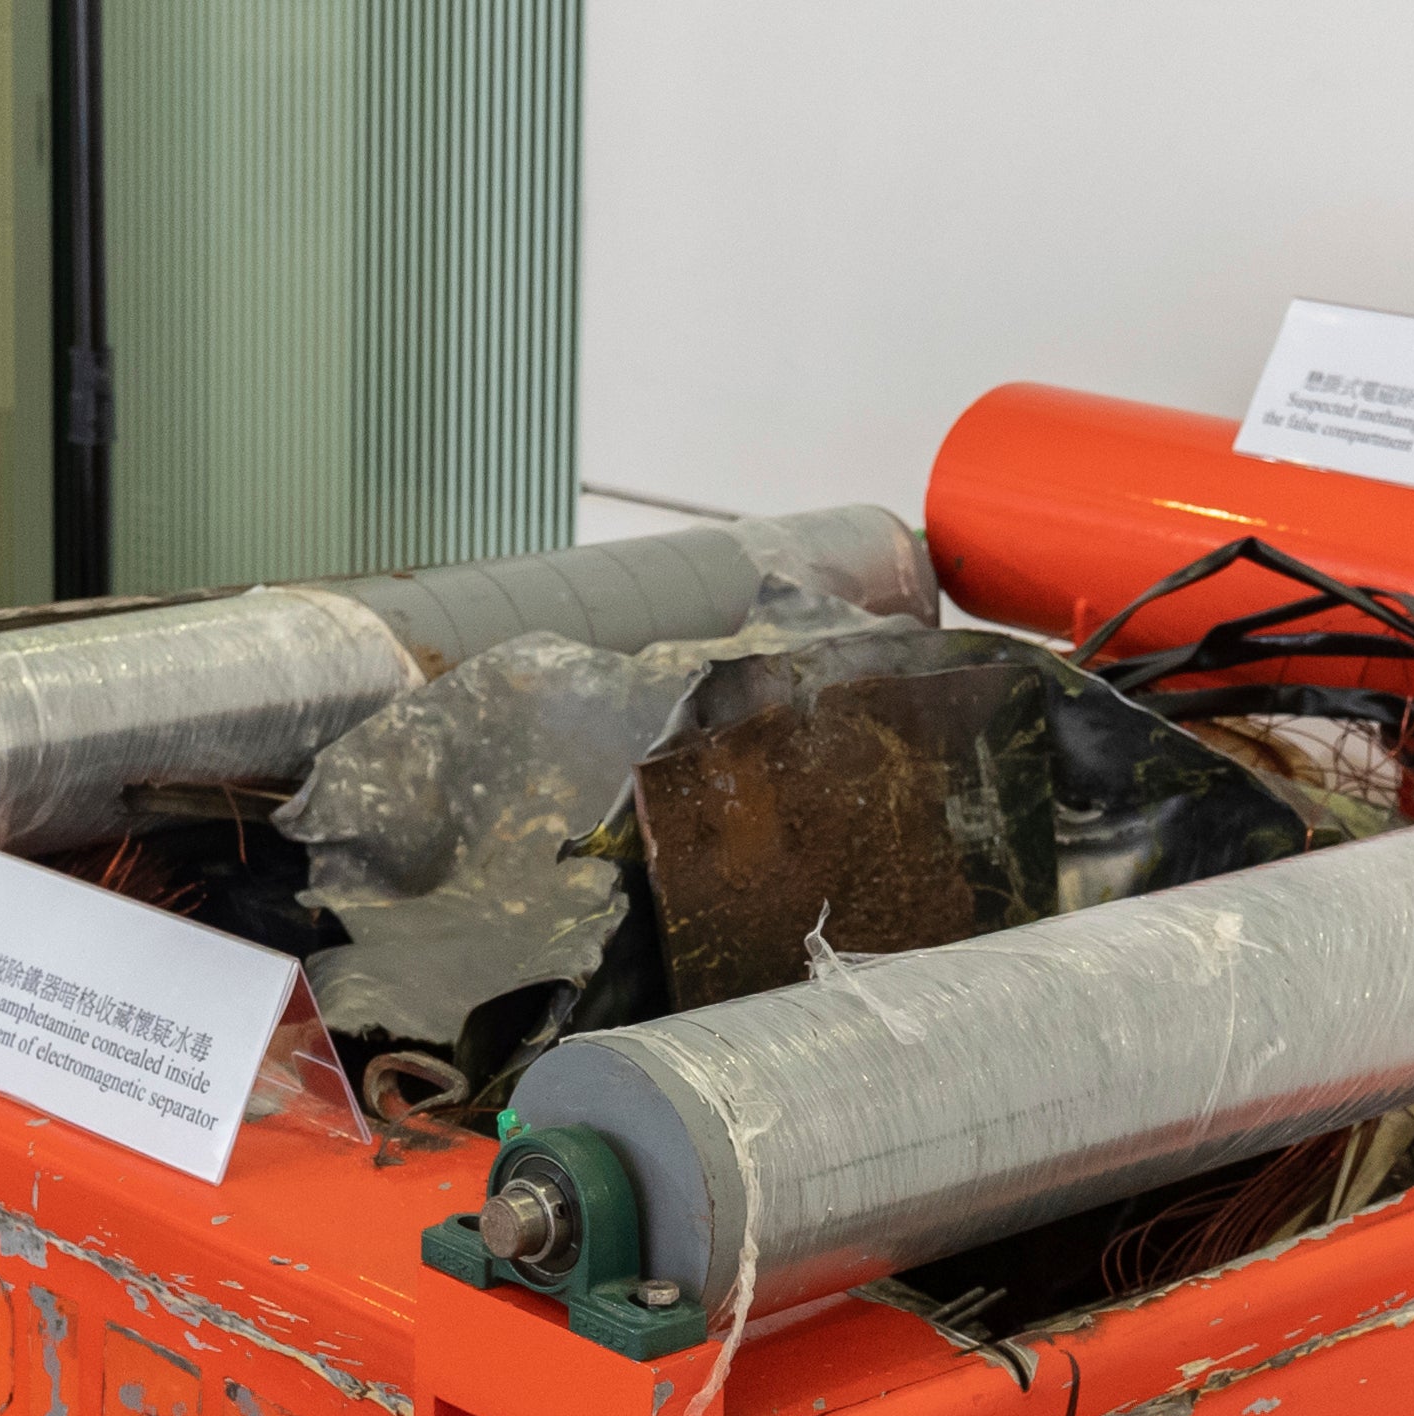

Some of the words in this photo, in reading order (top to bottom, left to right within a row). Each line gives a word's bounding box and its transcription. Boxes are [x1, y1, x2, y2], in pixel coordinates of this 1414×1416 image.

[1288, 391, 1357, 419] Suspected
[1262, 410, 1285, 427] the
[1287, 413, 1320, 434] false
[1320, 424, 1414, 453] compartment
[17, 1036, 40, 1056] of
[36, 1042, 147, 1102] electromagnetic
[148, 1090, 219, 1131] separator
[91, 1033, 166, 1076] concealed
[165, 1058, 211, 1094] inside
